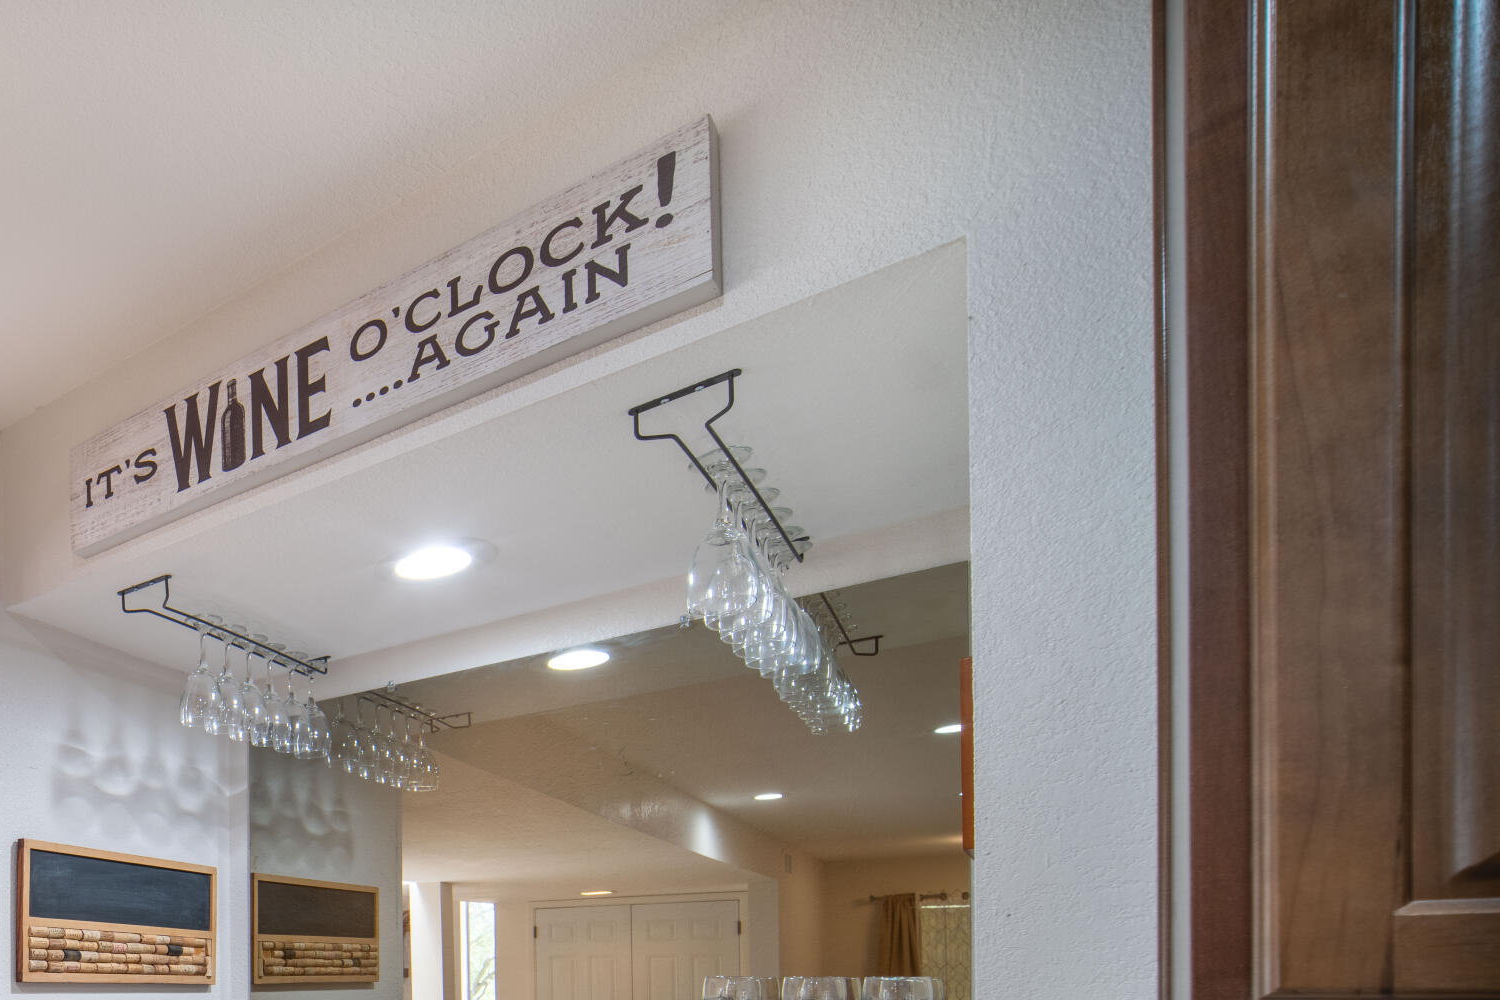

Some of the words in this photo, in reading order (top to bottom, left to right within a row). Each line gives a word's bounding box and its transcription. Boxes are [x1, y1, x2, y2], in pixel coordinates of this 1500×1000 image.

[84, 447, 158, 509] IT'S
[162, 335, 332, 493] WINE
[348, 150, 677, 362] O'CLOCK!
